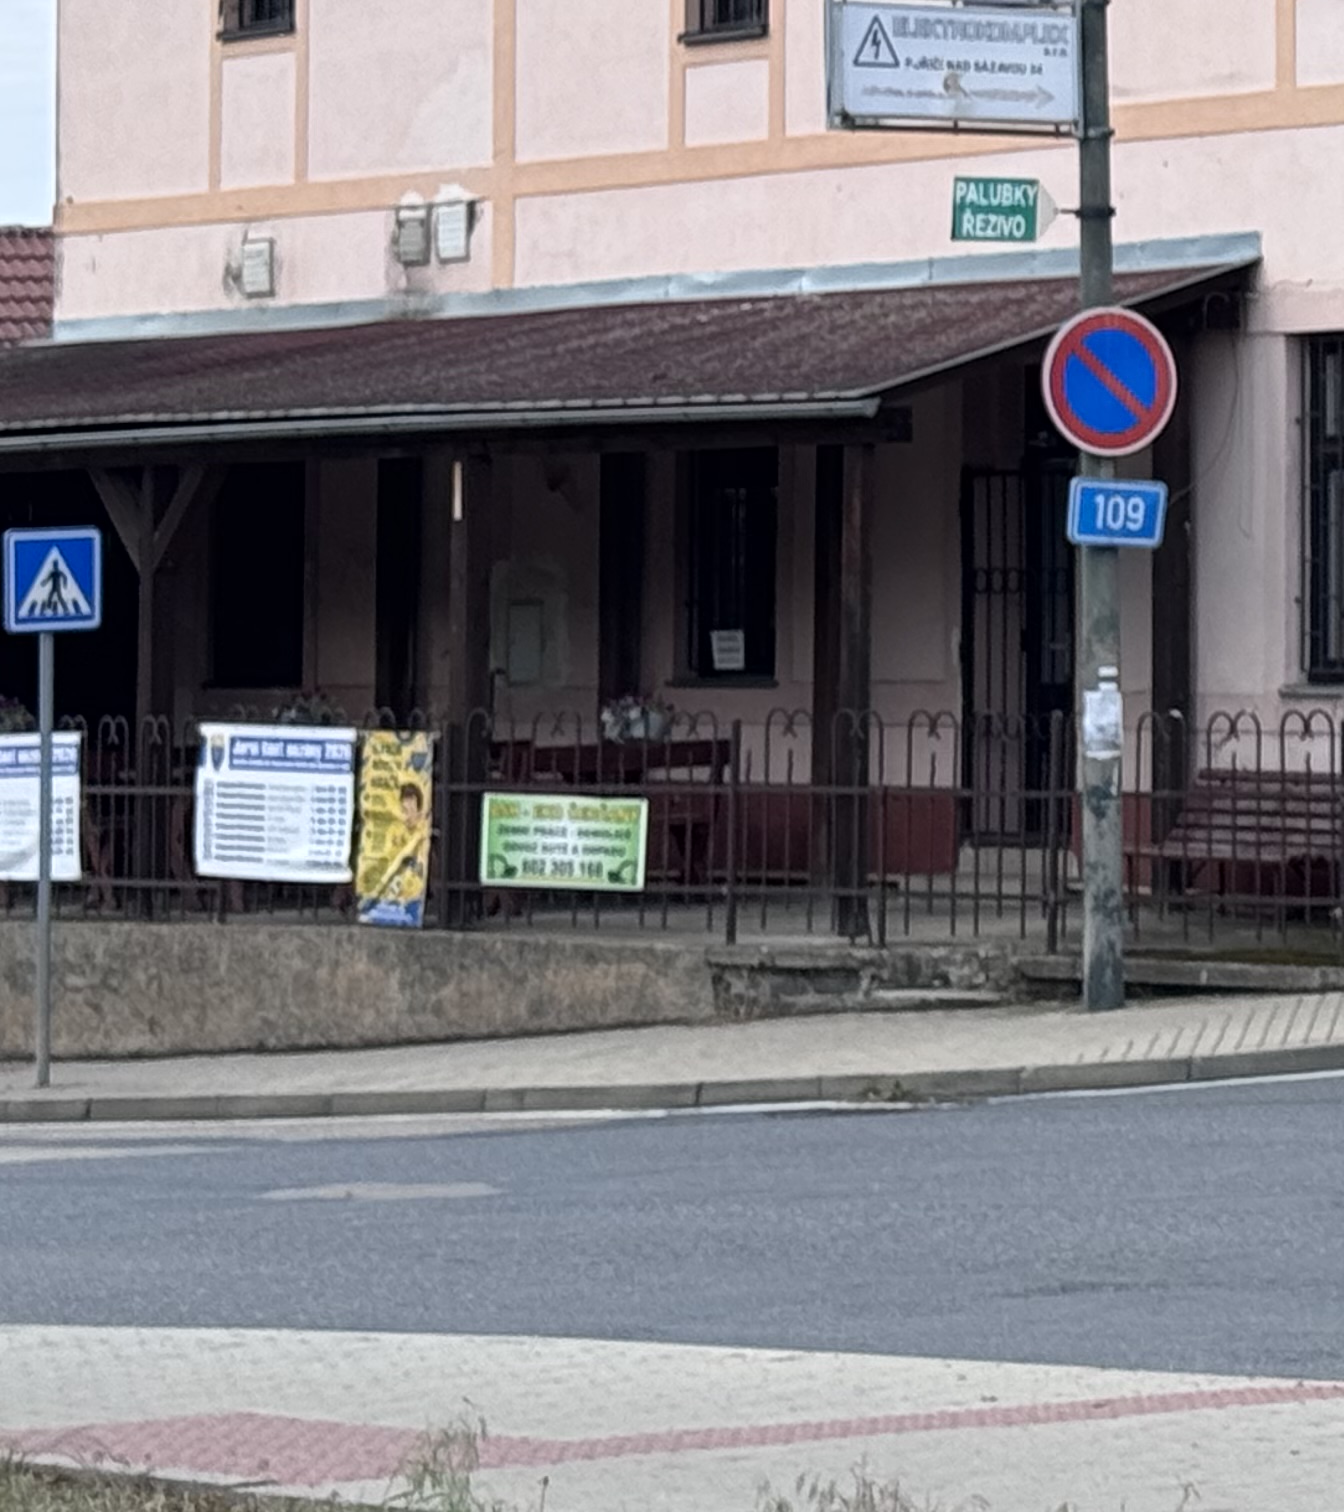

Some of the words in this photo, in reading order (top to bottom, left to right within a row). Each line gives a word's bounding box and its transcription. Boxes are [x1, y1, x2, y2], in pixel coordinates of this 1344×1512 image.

[955, 182, 1038, 207] PALUBKY
[962, 209, 1026, 239] ŘEZIVO
[1094, 494, 1145, 532] 109
